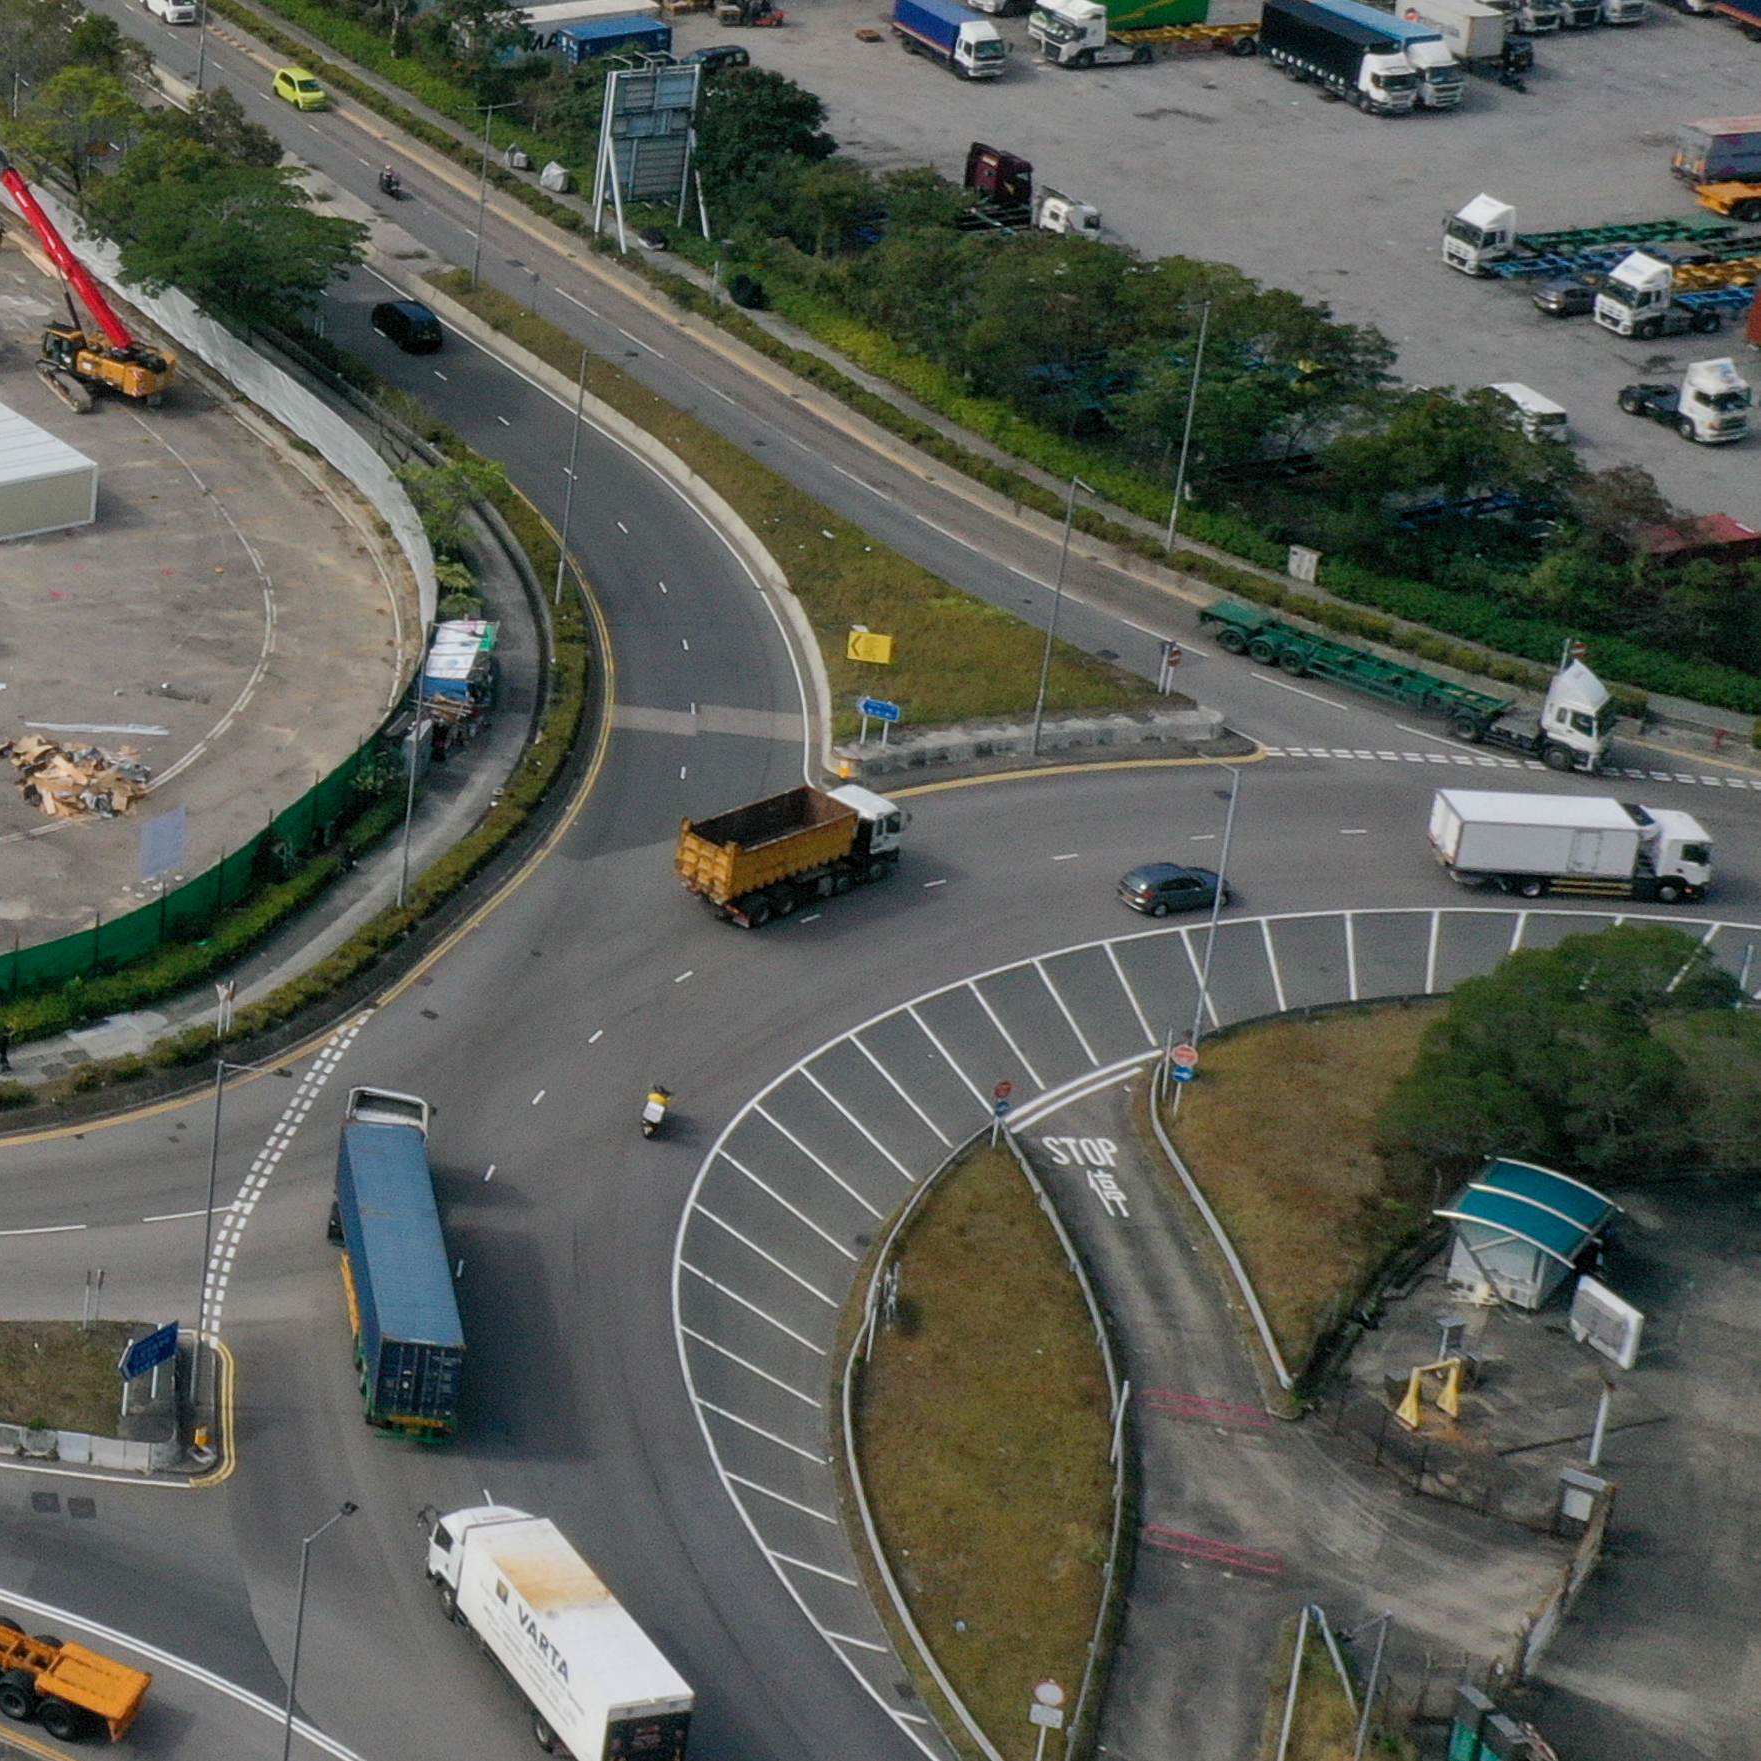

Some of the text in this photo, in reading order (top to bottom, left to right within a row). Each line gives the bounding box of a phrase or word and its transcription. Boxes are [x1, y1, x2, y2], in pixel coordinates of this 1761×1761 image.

[1041, 1136, 1118, 1167] STOP
[1086, 1169, 1130, 1218] 停
[518, 1603, 570, 1684] VARTA
